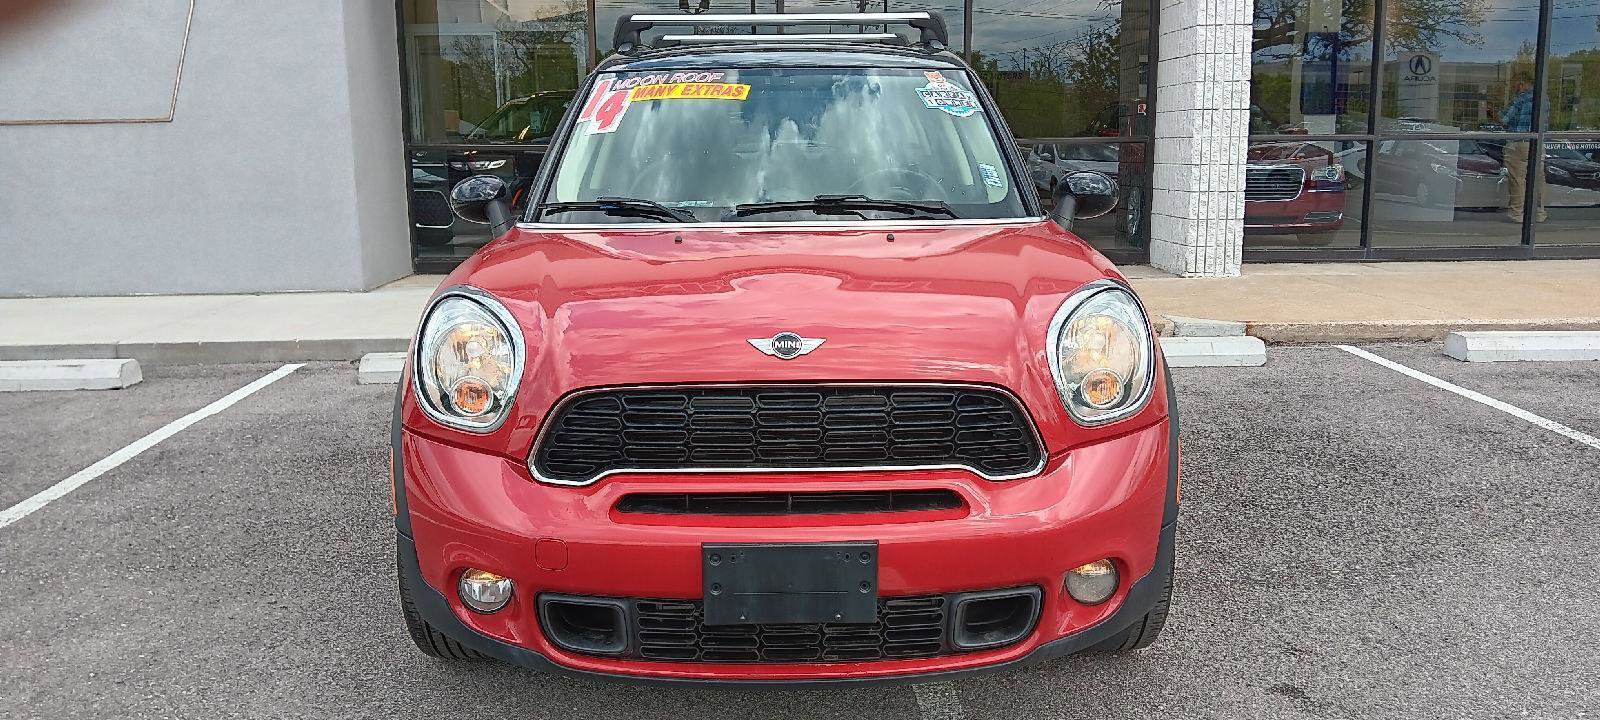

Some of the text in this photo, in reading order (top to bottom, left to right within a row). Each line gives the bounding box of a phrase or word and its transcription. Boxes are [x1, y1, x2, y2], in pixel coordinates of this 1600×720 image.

[614, 72, 725, 90] MOON ROOF
[632, 85, 745, 99] MANY EXTRAS
[774, 340, 800, 349] MINI
